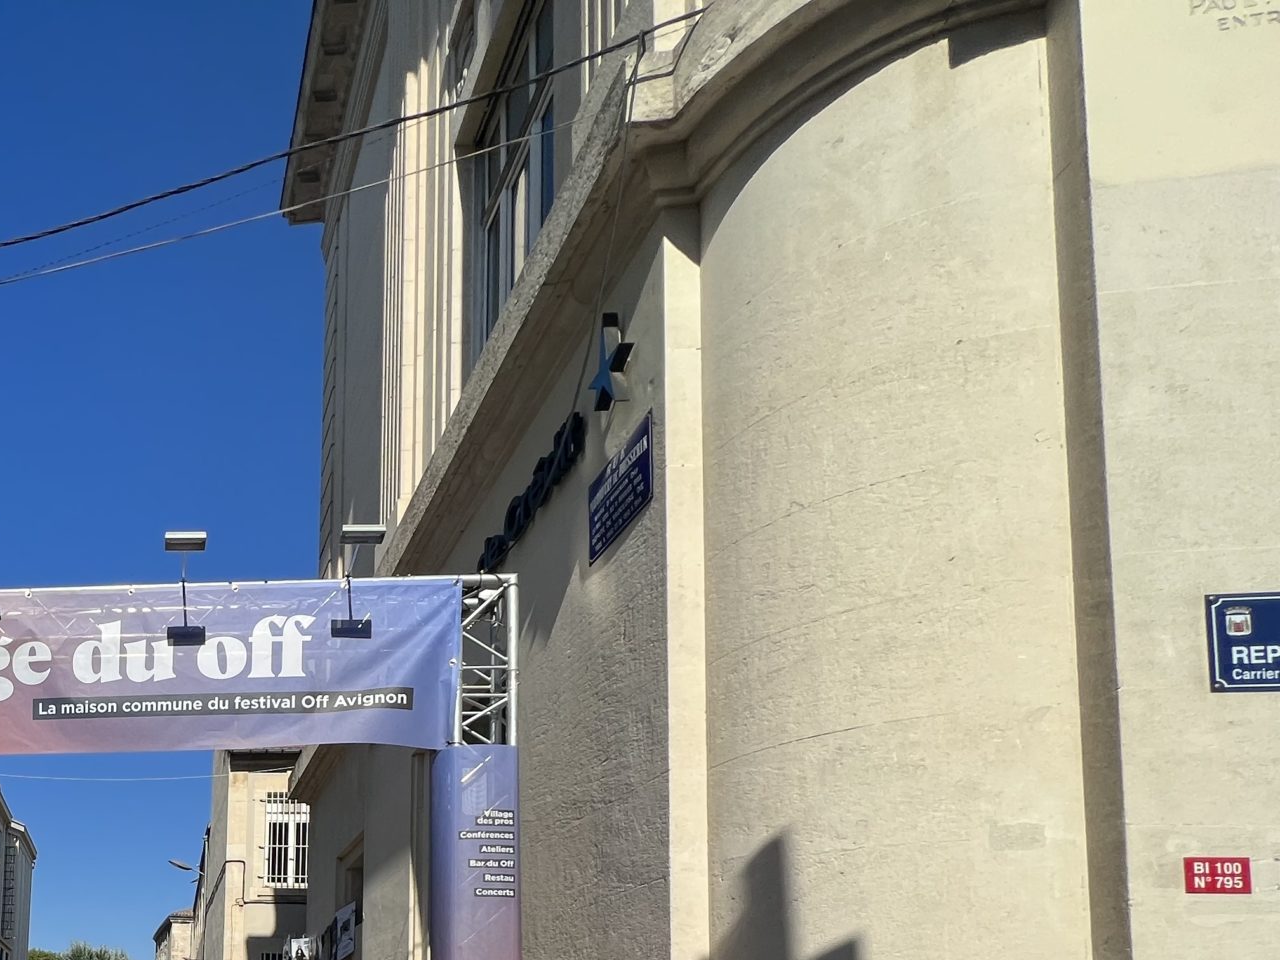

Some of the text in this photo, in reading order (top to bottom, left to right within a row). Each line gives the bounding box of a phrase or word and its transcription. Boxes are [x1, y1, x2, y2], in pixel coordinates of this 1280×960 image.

[72, 620, 177, 683] du
[197, 614, 316, 679] off
[1231, 645, 1280, 664] REP
[1232, 668, 1280, 680] Carrier
[39, 690, 407, 715] La maison commune du festival Off Avignon
[484, 810, 514, 819] Village
[477, 817, 514, 826] des pros
[460, 831, 514, 839] Conférences
[480, 845, 514, 853] Ateliers
[469, 859, 486, 867] Bar
[486, 859, 499, 867] du
[1215, 863, 1242, 874] 100
[484, 874, 514, 882] Restau
[1194, 877, 1243, 888] N° 795
[475, 888, 514, 896] Concerts
